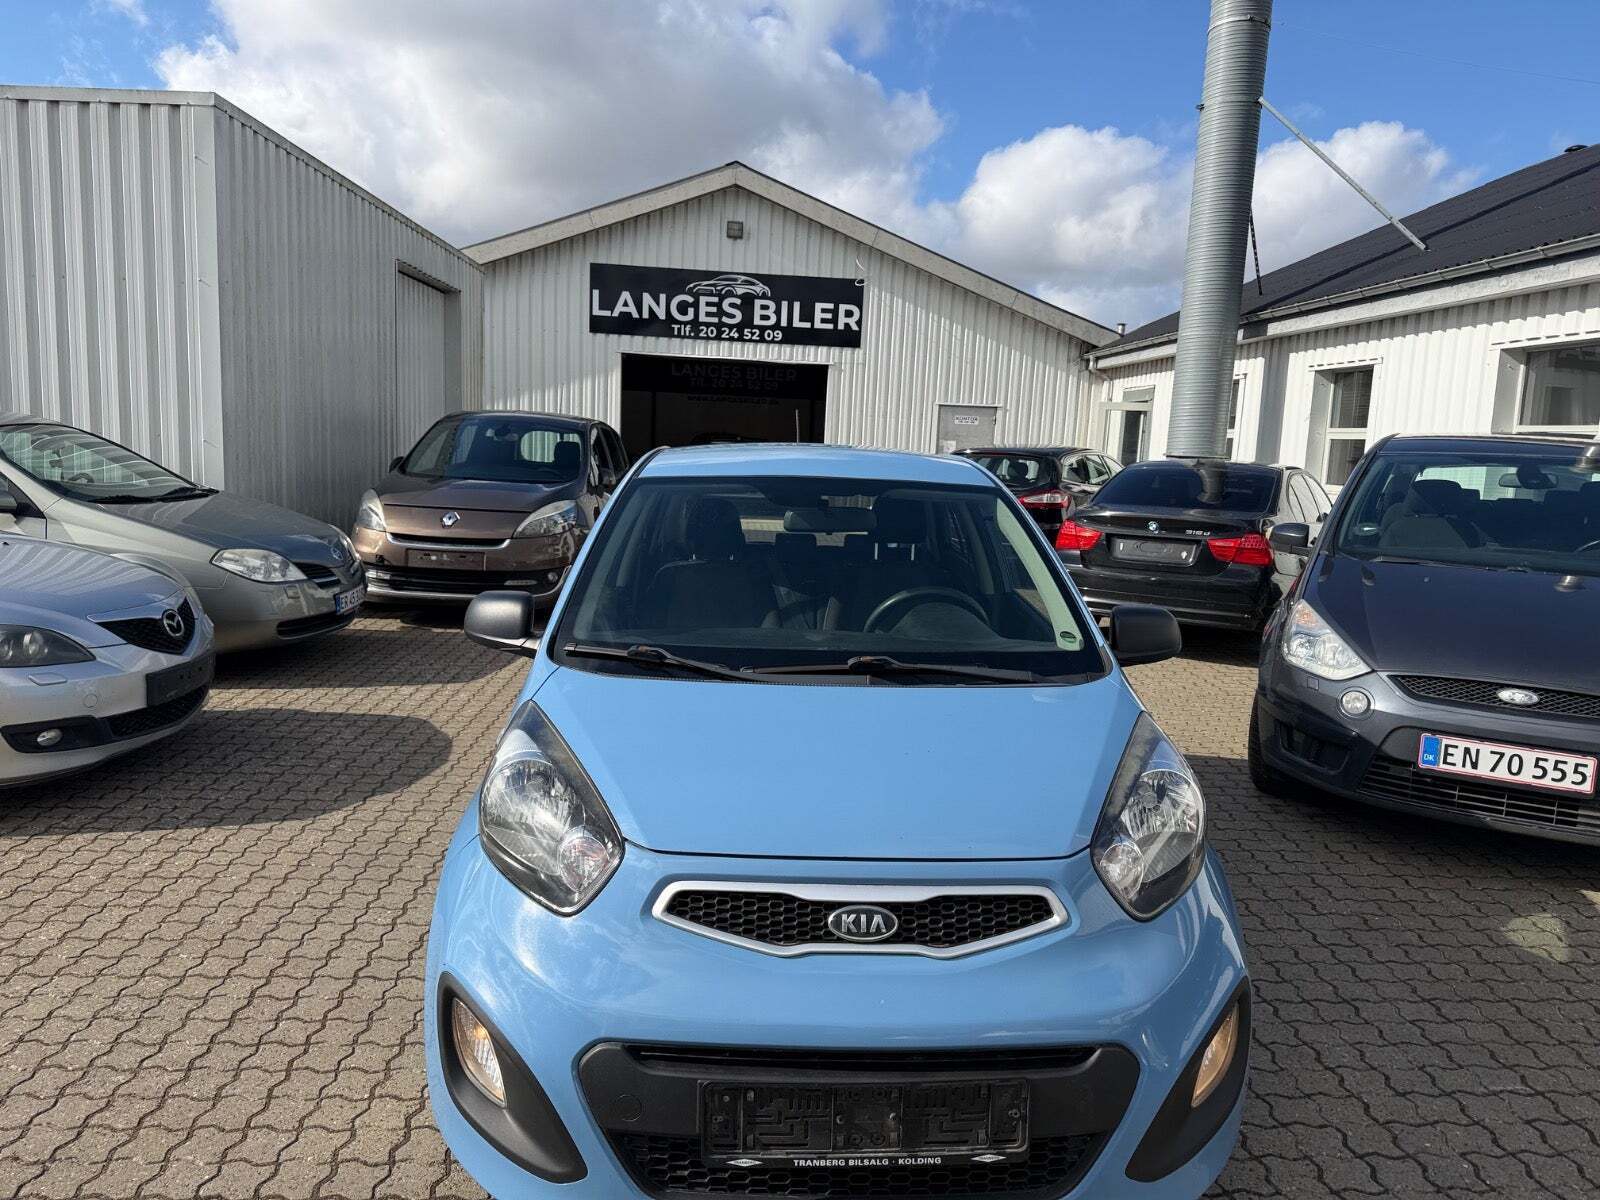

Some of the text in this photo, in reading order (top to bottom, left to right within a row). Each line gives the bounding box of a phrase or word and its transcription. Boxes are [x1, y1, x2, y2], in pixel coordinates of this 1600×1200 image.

[591, 288, 861, 331] LANGES BILER
[671, 324, 783, 341] Tlf. 20 24 52 09
[671, 362, 797, 382] LANGES BILER
[1423, 753, 1435, 762] DK
[1442, 742, 1589, 785] EN 70 555
[841, 913, 886, 933] KIA
[793, 1156, 942, 1167] TRANBERG BILSALG KOLDING
